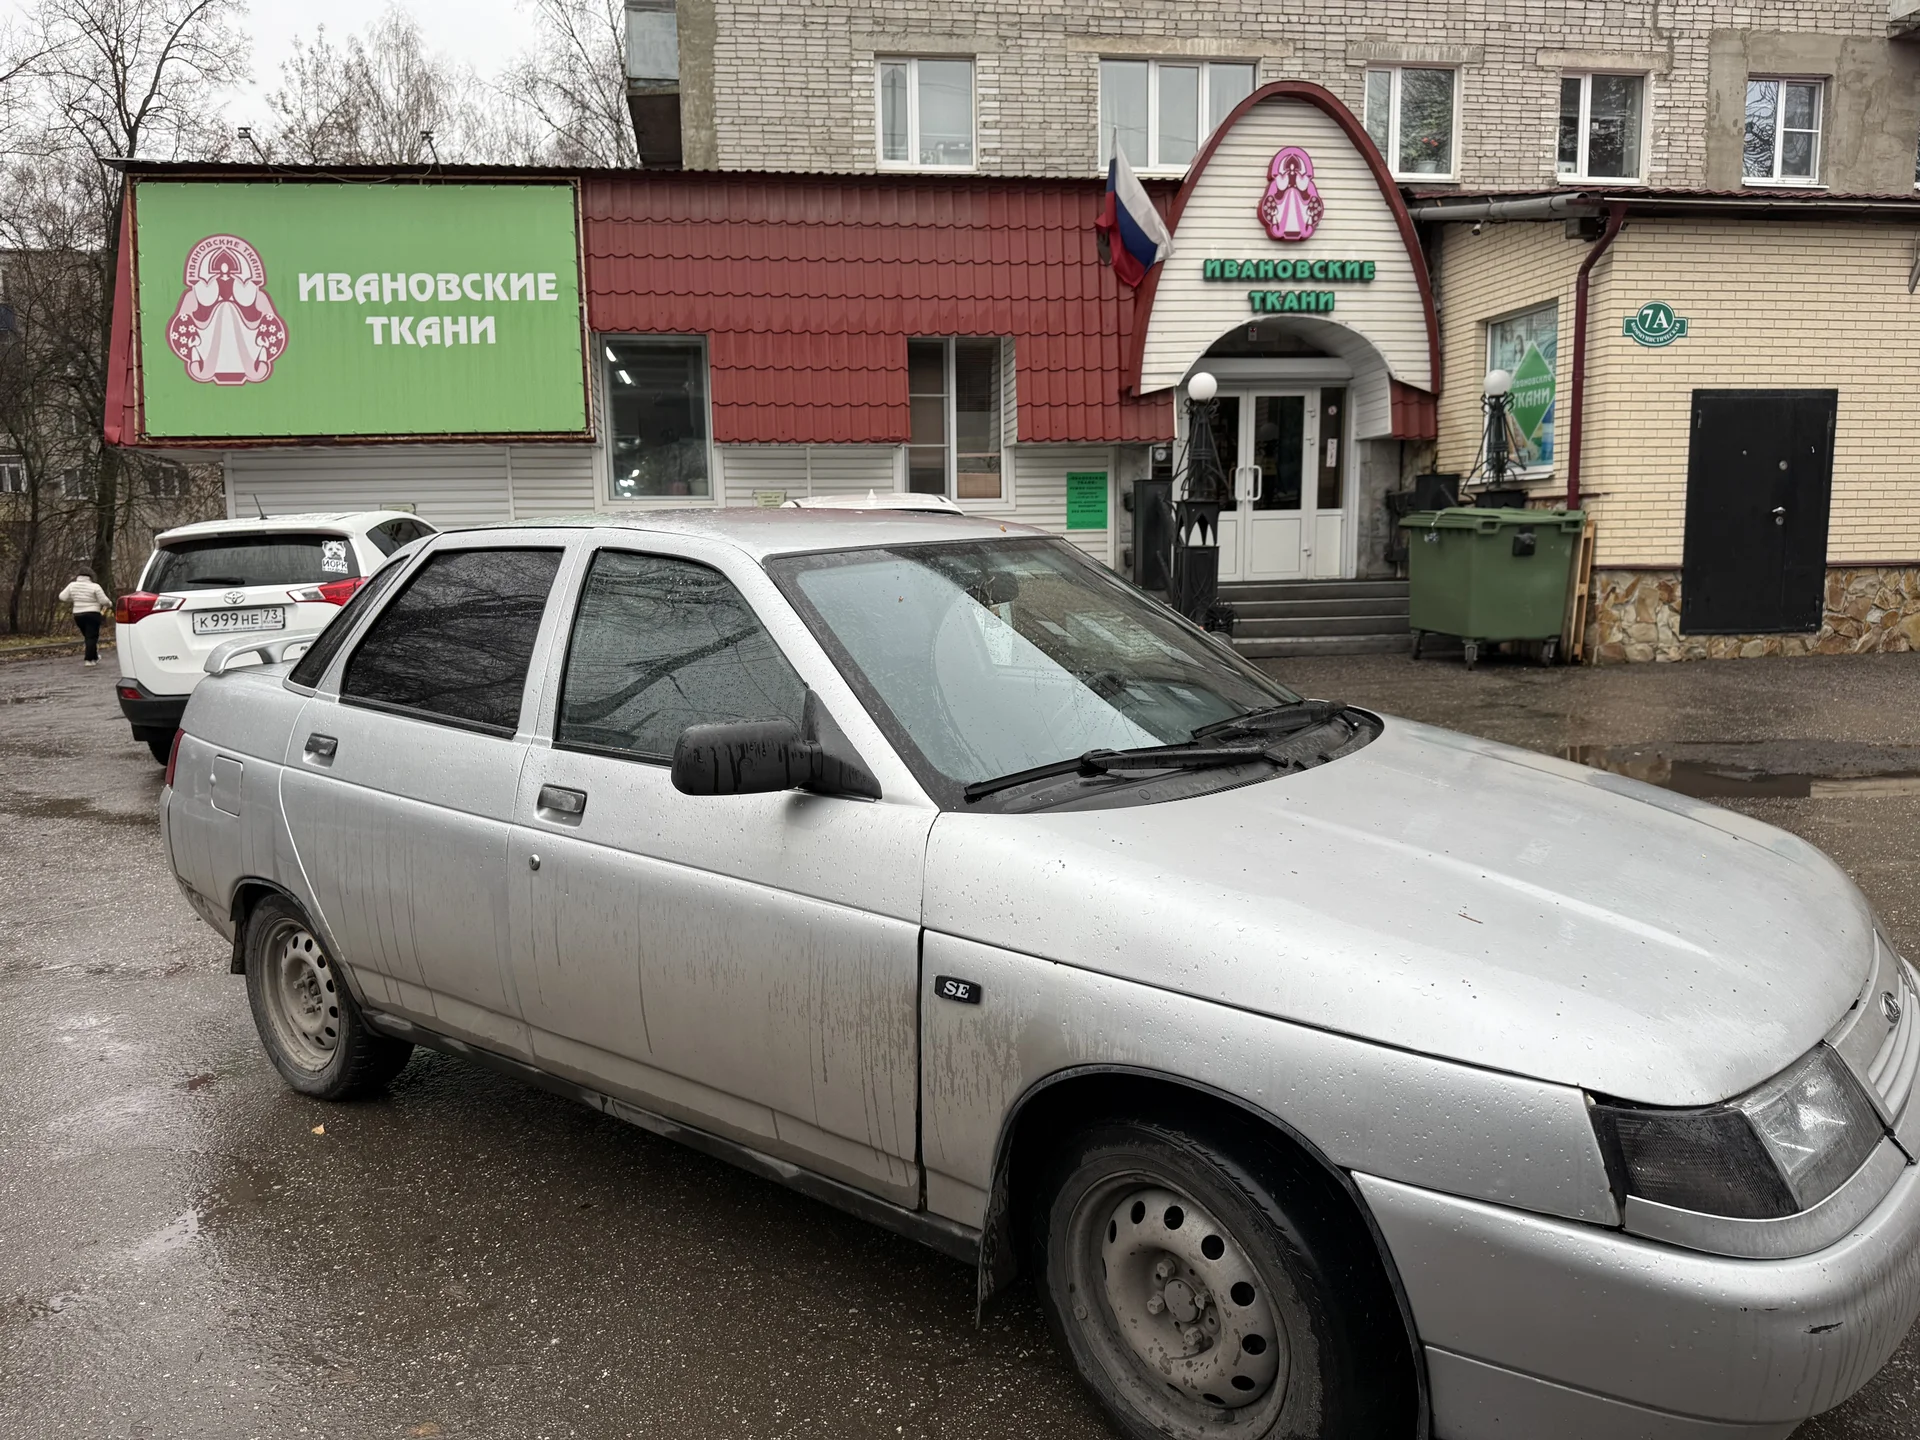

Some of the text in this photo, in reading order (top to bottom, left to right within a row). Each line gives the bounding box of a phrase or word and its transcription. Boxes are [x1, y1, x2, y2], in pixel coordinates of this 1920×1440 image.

[188, 239, 263, 279] ИВАНОВСКИЕ ТКАНИ
[1203, 259, 1376, 281] ИВАНОВСКИЕ
[298, 272, 559, 305] ИВАНОВСКИЕ
[1249, 291, 1335, 312] ТКАНИ
[1642, 309, 1669, 329] 7А
[365, 315, 497, 348] ТКАНИ
[1630, 321, 1681, 343] КОММУНИСТИЧЕСКАЯ
[263, 609, 278, 620] 73
[943, 980, 970, 999] SE
